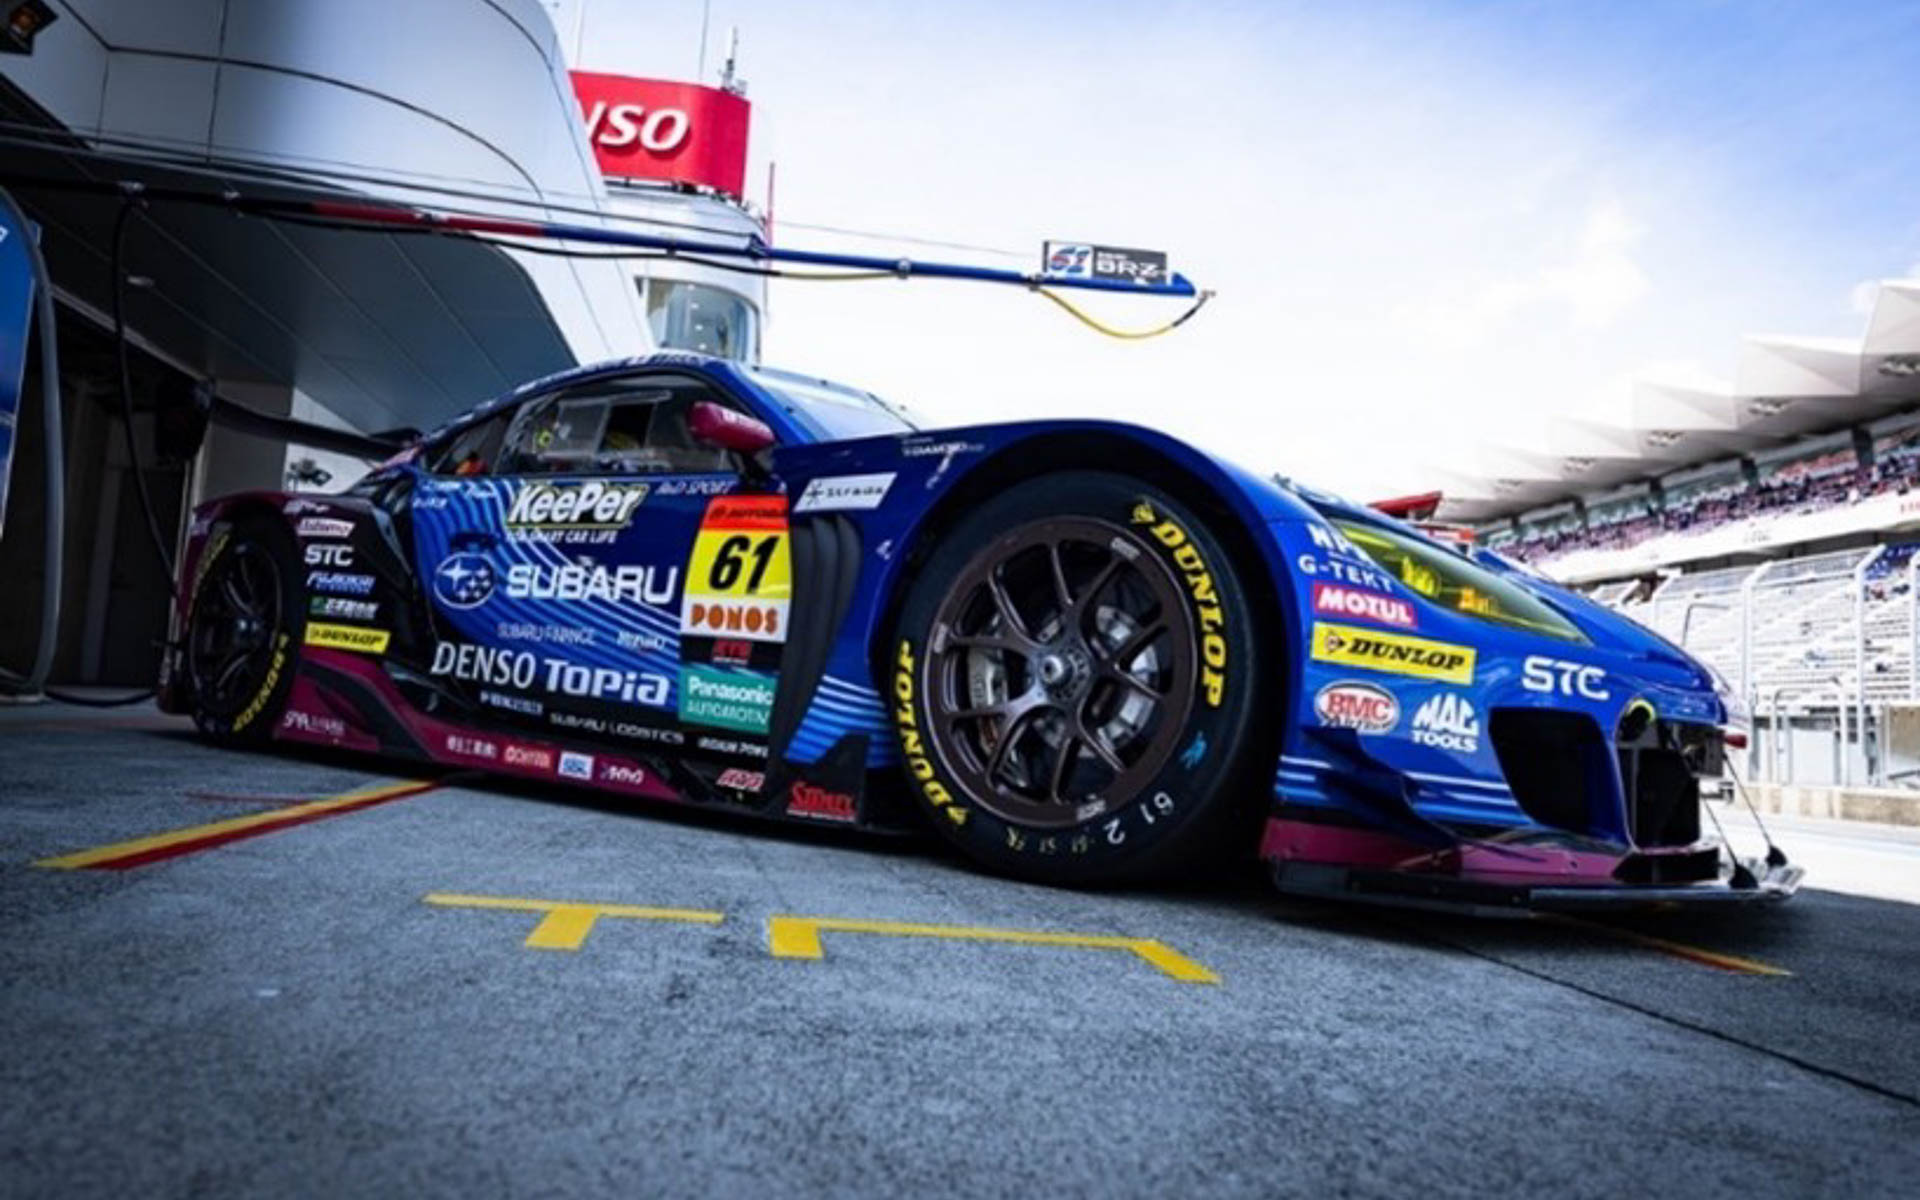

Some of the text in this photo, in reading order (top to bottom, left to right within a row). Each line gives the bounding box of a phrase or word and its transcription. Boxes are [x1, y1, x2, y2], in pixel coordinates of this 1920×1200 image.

[508, 483, 641, 523] KeePer
[304, 544, 355, 567] STC
[709, 535, 780, 595] 61
[506, 565, 678, 604] SUBARU
[690, 603, 778, 634] PONOS
[1151, 521, 1227, 708] DUNLOP
[1318, 588, 1413, 625] MOTUL
[430, 641, 537, 689] DENSO
[543, 659, 671, 706] Topia
[1347, 637, 1465, 671] DUNLOP
[688, 676, 774, 706] Panasonic
[1522, 655, 1610, 700] STC
[895, 640, 952, 806] DUNLOP
[1326, 692, 1391, 721] BMC
[1412, 692, 1480, 736] MAC
[1412, 731, 1478, 752] TOOLS
